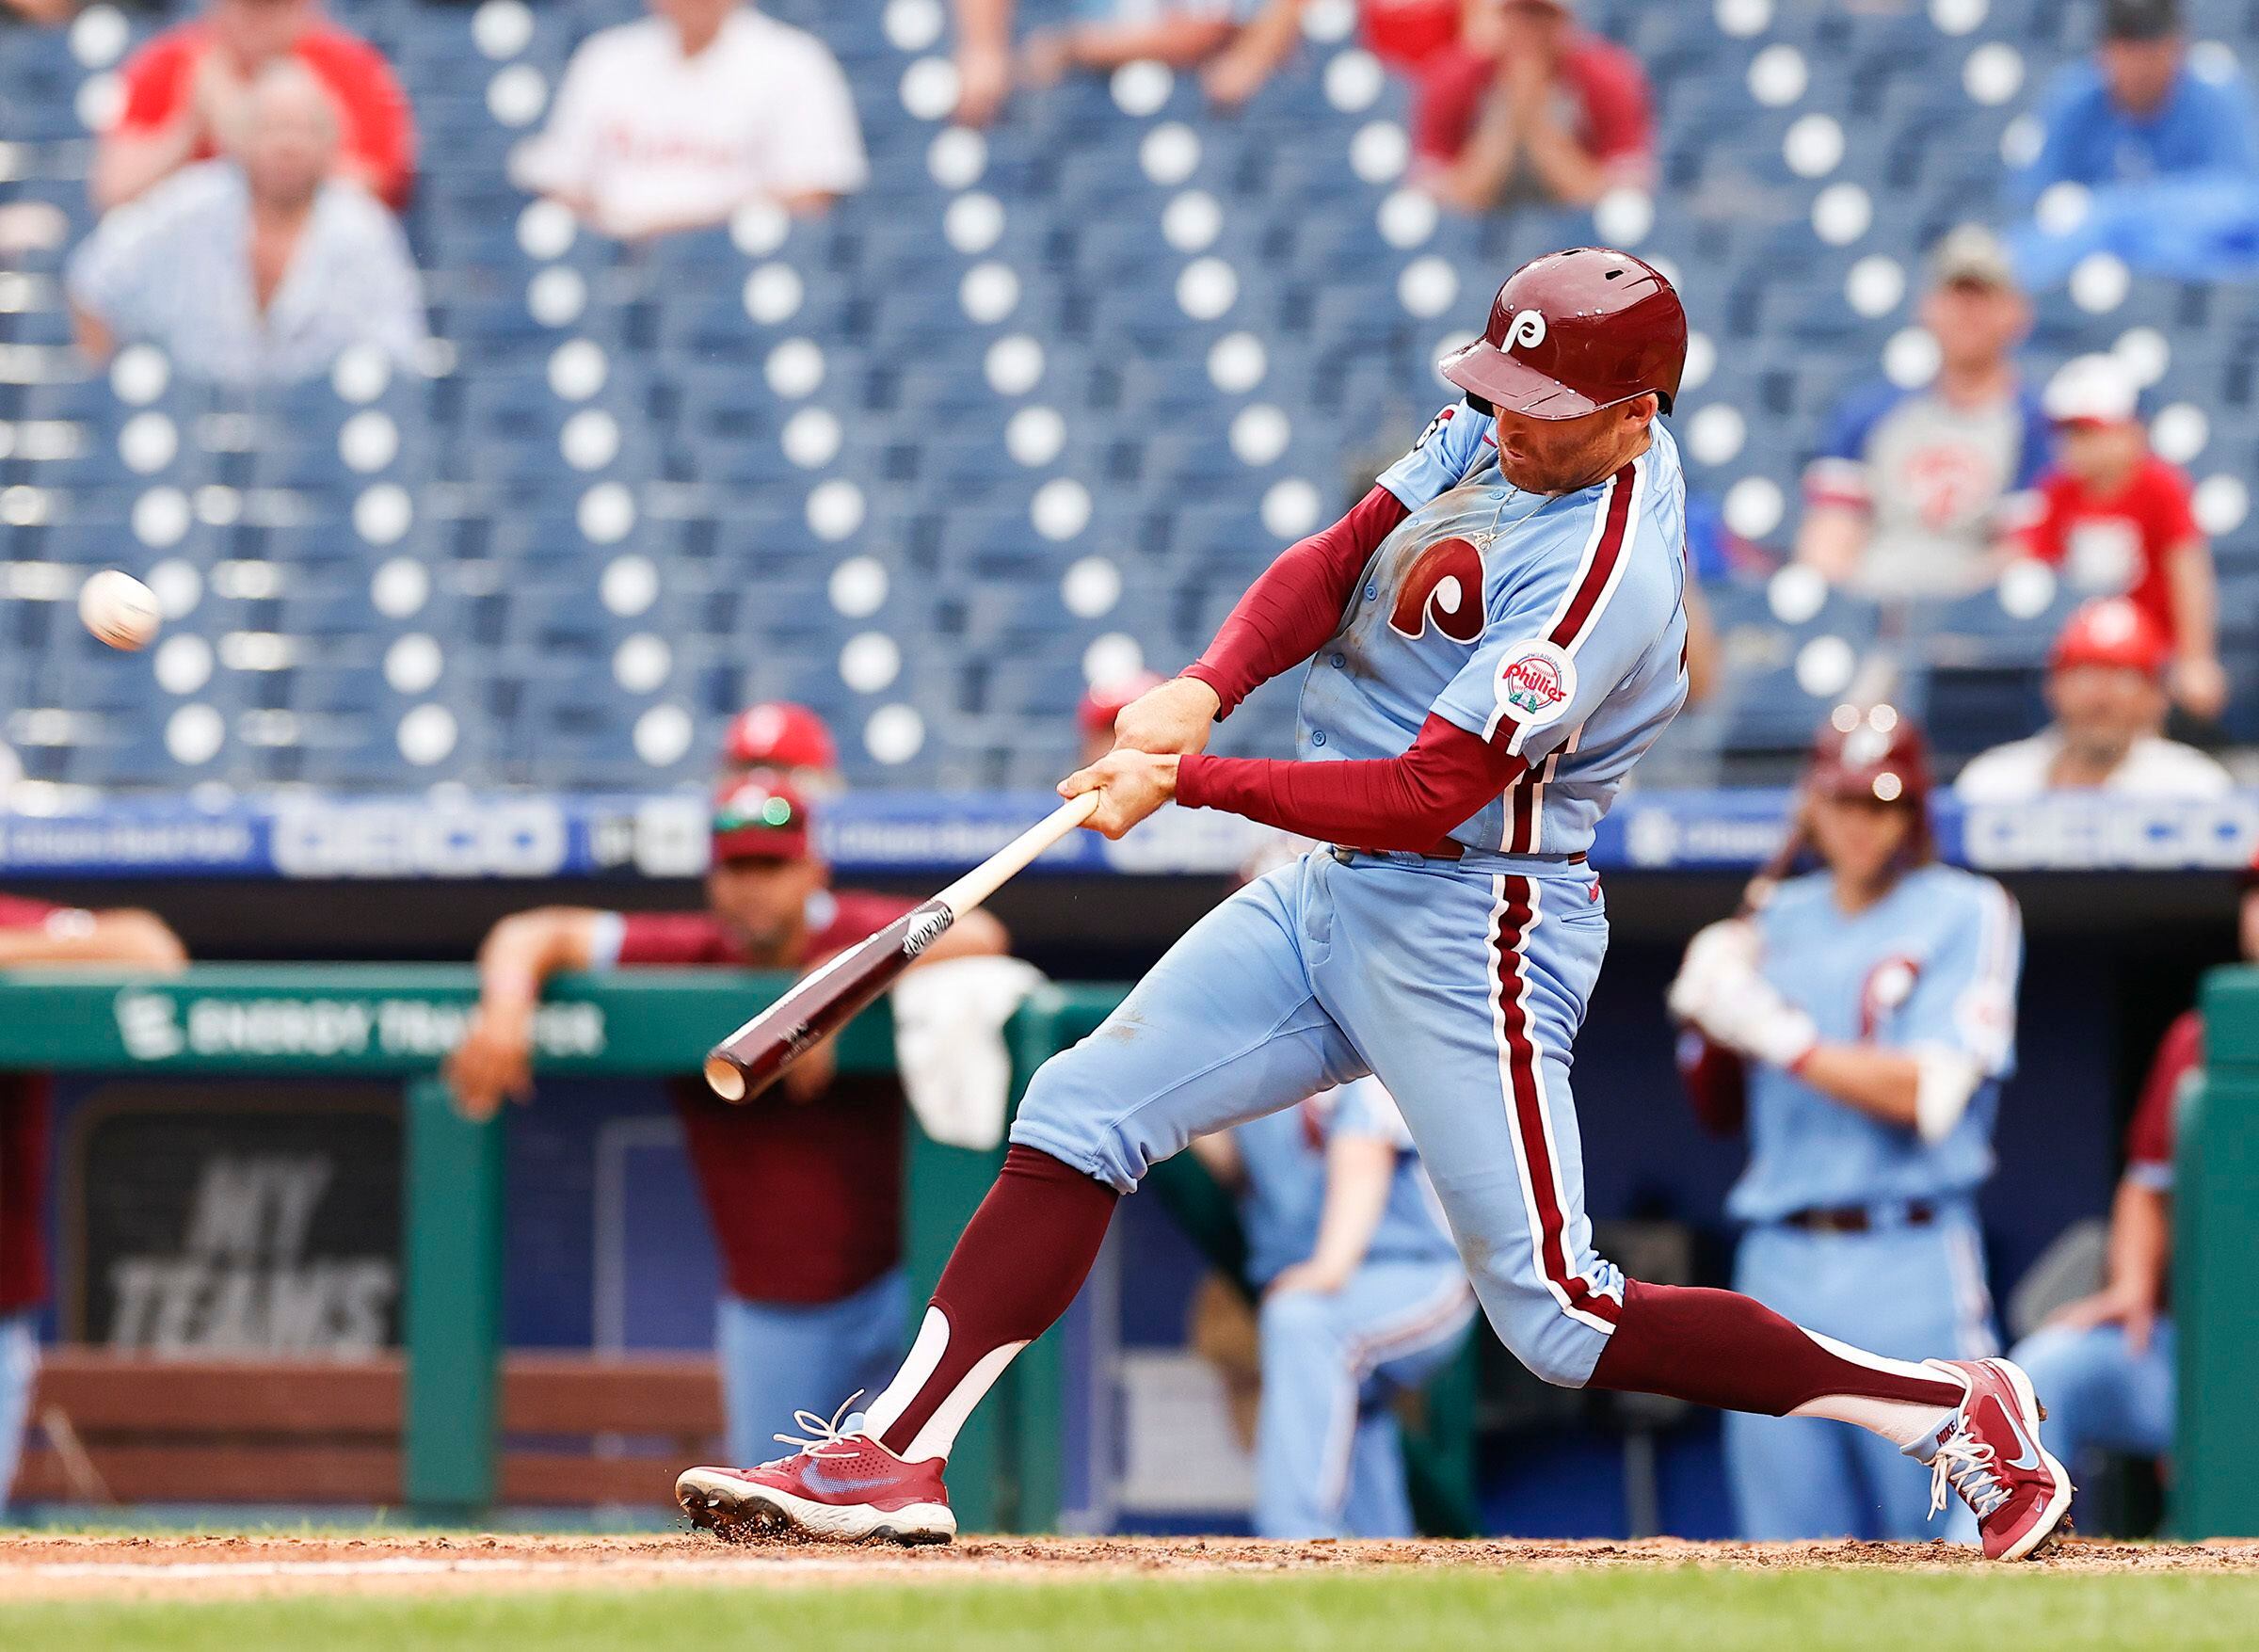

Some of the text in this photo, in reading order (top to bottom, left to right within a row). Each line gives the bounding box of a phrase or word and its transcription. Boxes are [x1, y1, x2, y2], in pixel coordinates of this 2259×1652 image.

[1501, 663, 1567, 703] Phillies
[109, 1255, 397, 1362] TEAMS
[1935, 1419, 1958, 1447] NIKE
